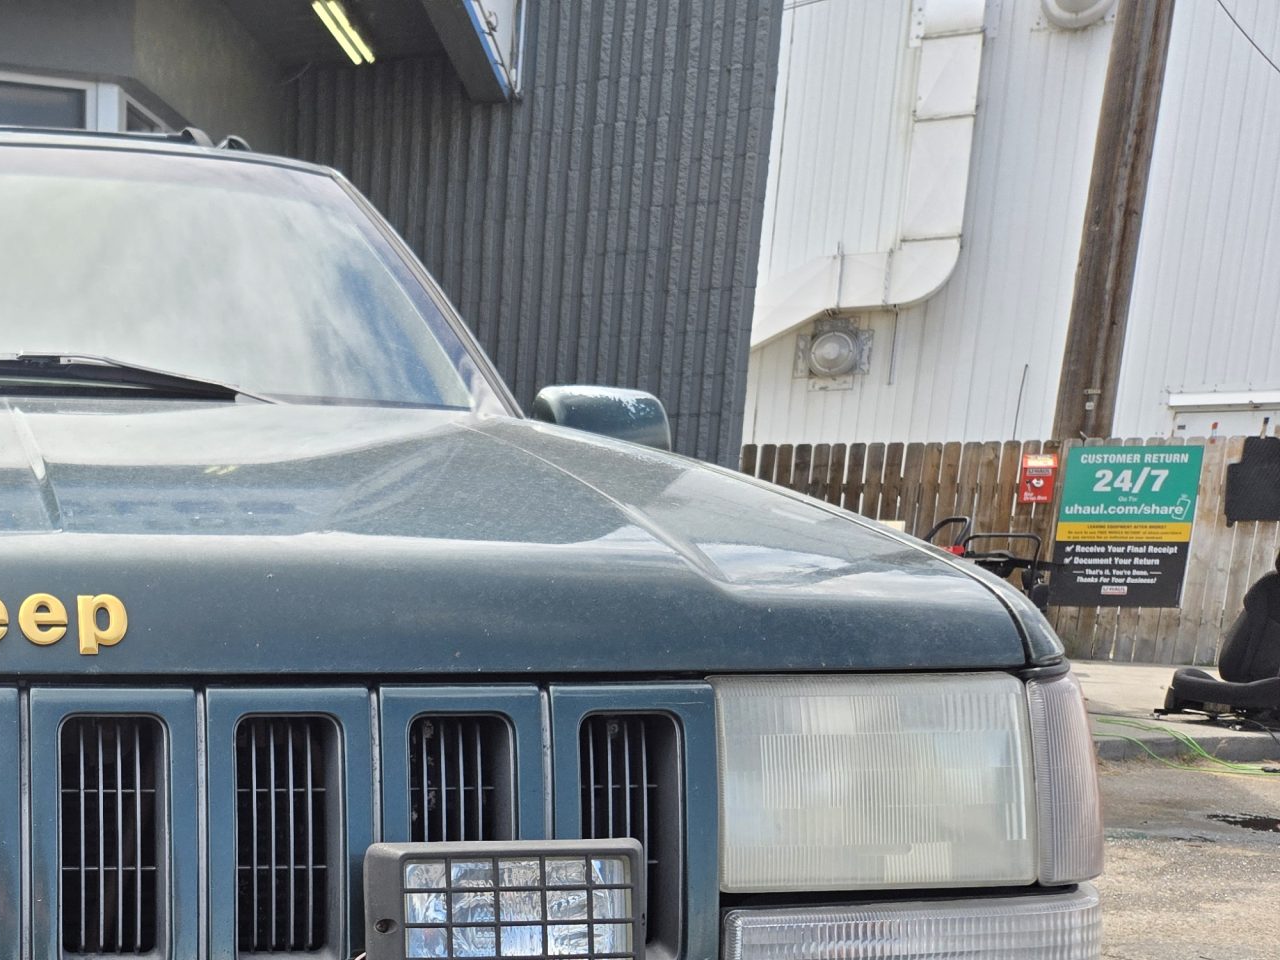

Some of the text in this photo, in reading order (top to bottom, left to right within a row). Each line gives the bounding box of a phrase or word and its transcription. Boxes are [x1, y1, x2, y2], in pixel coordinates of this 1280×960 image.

[1080, 453, 1189, 464] CUSTOMER RETURN
[1092, 467, 1169, 493] 24/7
[1065, 503, 1183, 515] uhaul.com/share
[1075, 545, 1178, 555] Receive Your Final Receipt
[1073, 556, 1160, 565] Document Your Return
